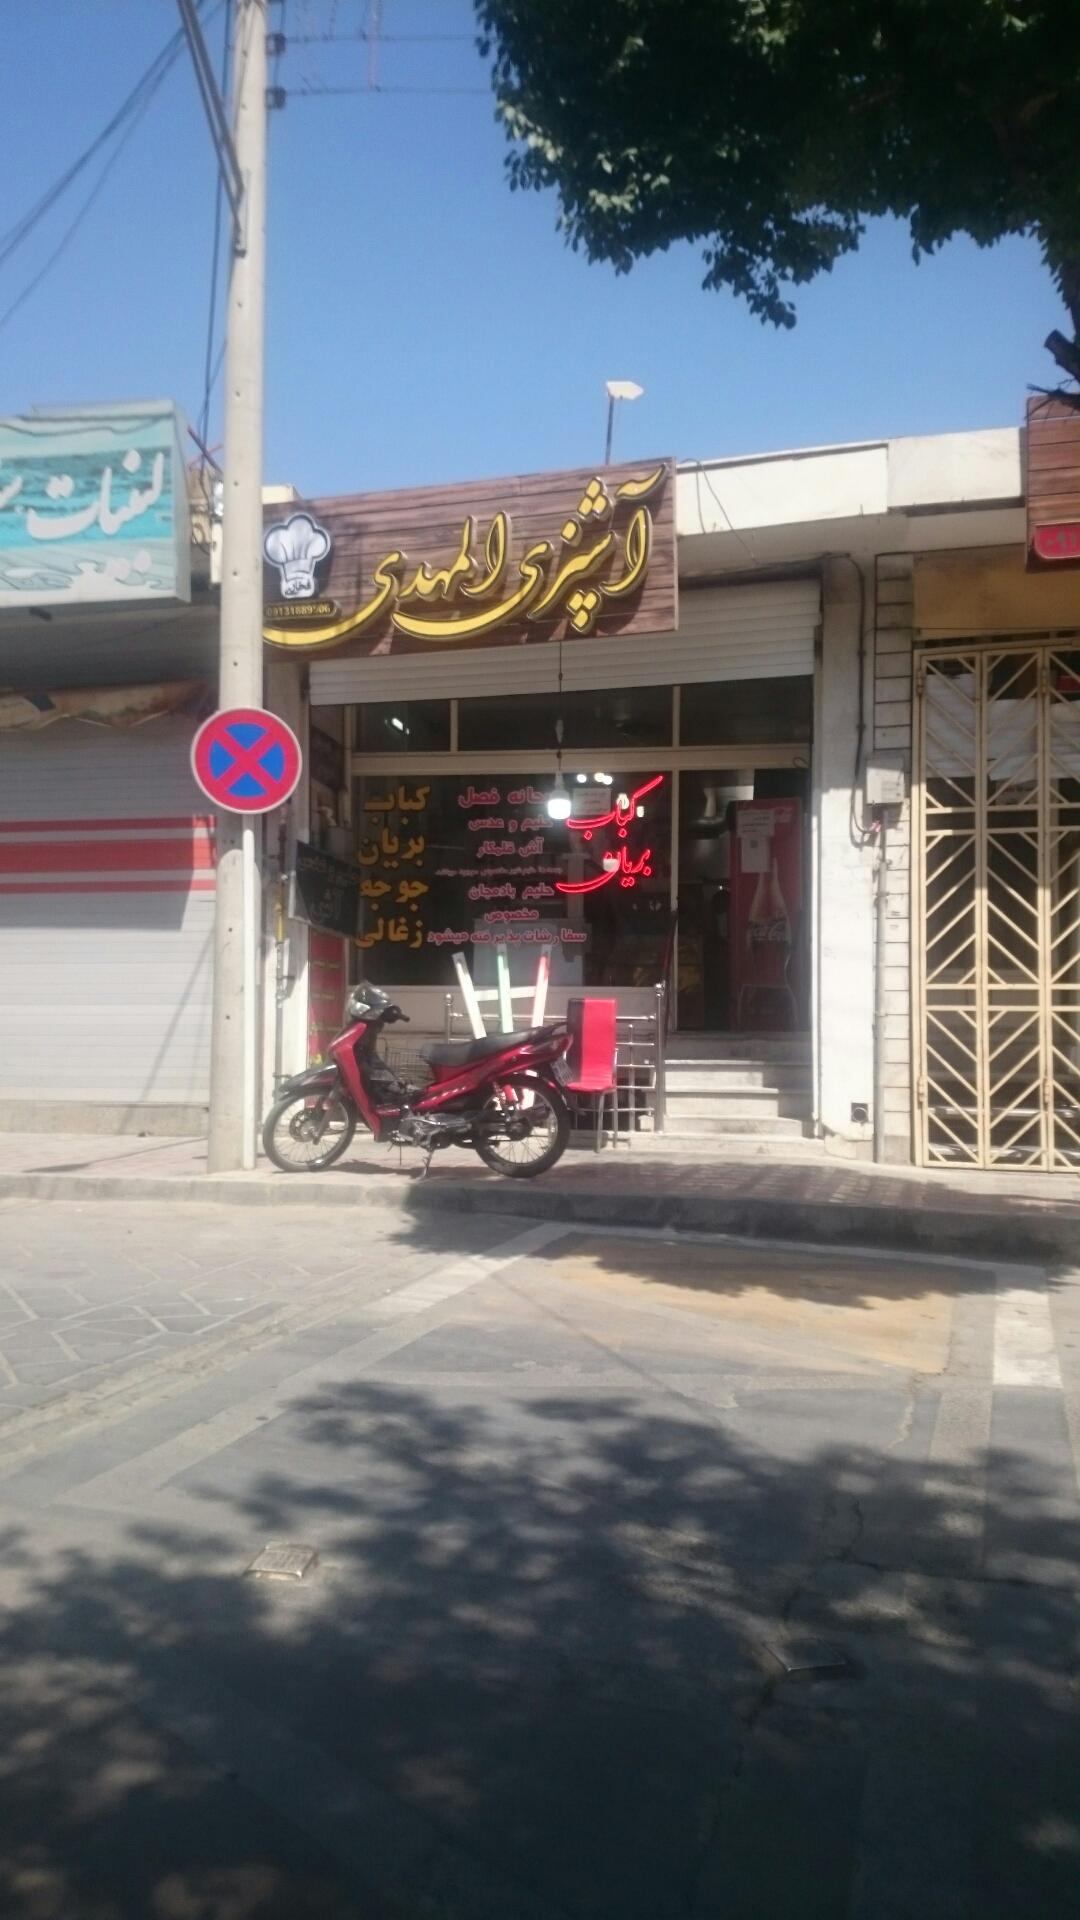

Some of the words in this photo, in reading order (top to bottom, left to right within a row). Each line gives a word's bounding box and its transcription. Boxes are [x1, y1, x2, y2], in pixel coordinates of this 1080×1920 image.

[27, 448, 165, 581] لبنیات
[391, 463, 669, 640] آشپزی
[263, 511, 510, 651] المهدی
[363, 784, 431, 826] کباب
[458, 786, 500, 809] فصل
[507, 786, 551, 805] حانه
[566, 775, 664, 840] کباب
[508, 819, 518, 833] و
[357, 826, 425, 868] بریان
[556, 846, 652, 893] بریان
[359, 879, 430, 912] جوجه
[468, 882, 517, 901] بادمجان
[521, 882, 555, 901] حلیم
[355, 916, 423, 949] زغالی
[484, 907, 541, 925] مخصوص
[426, 927, 470, 946] میشود
